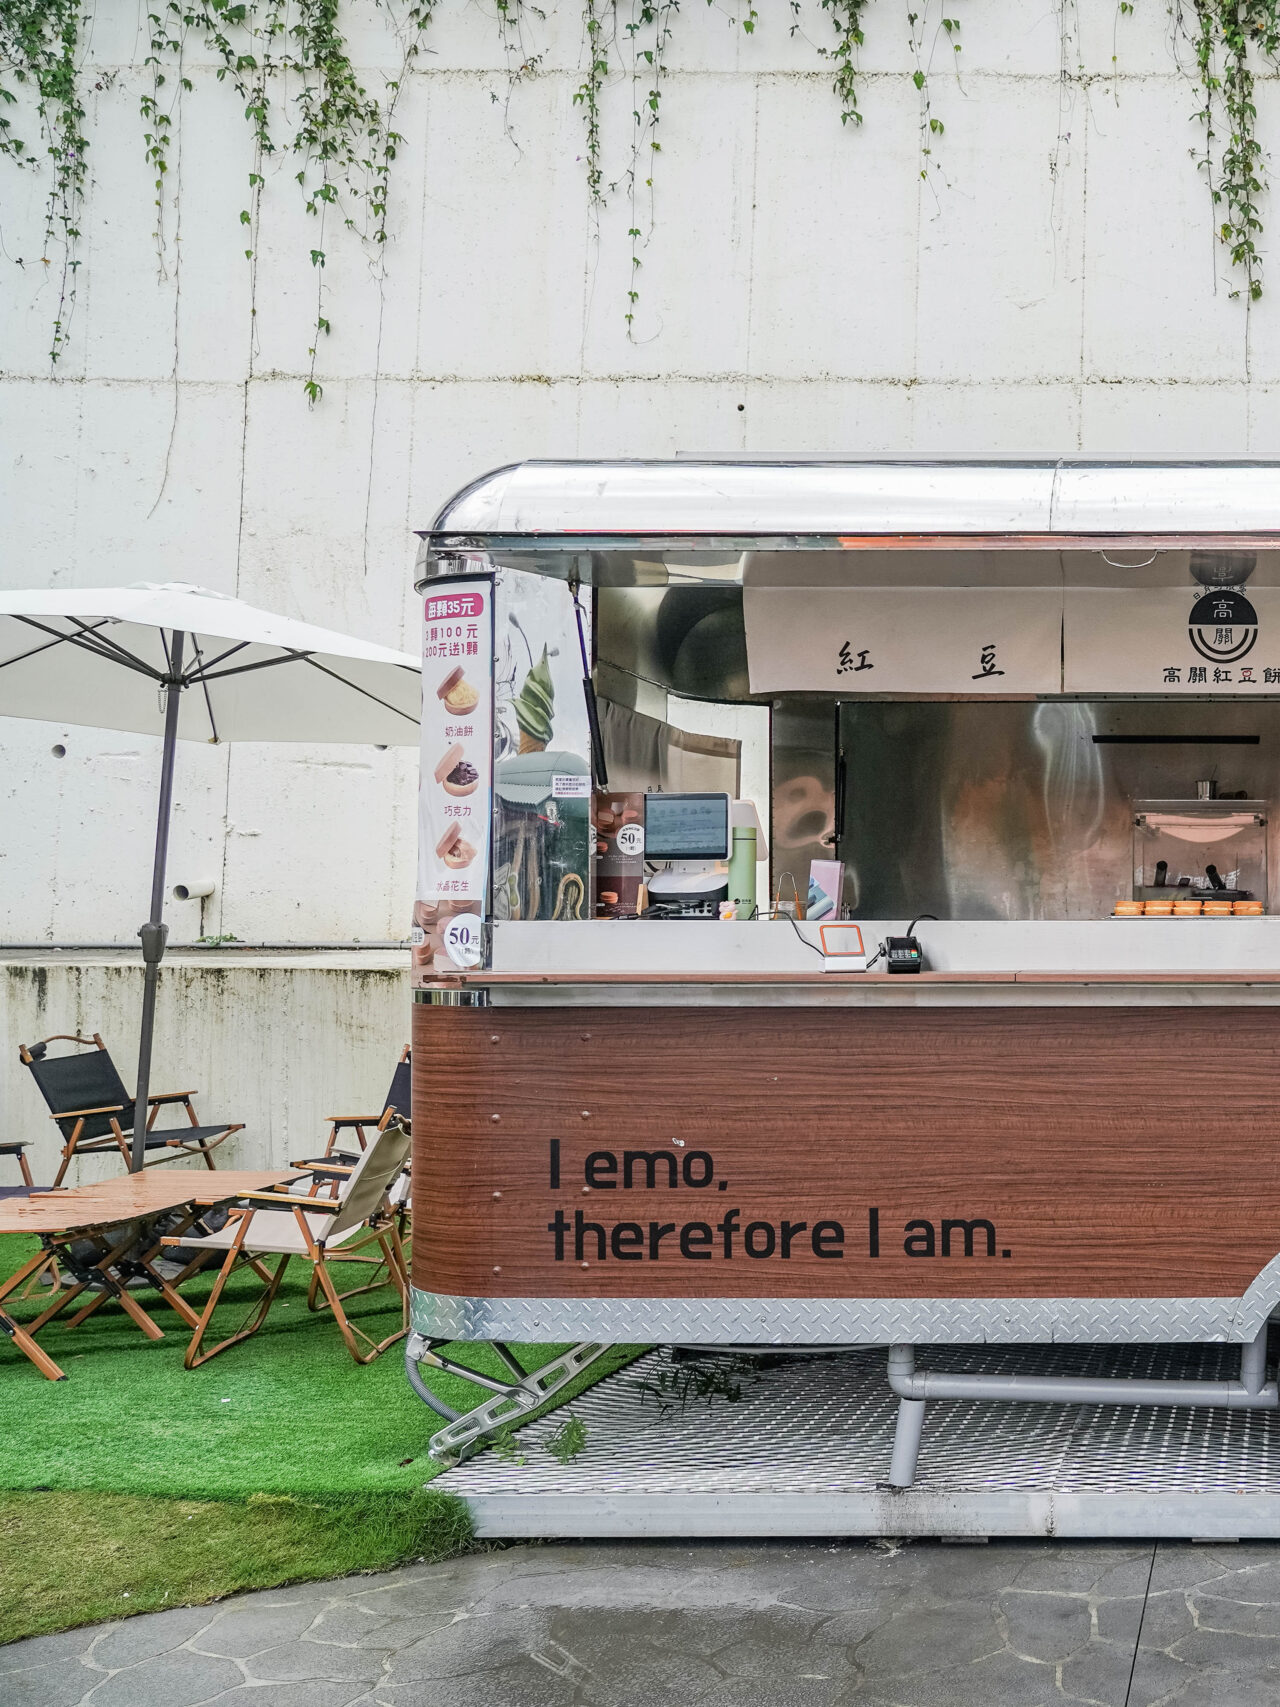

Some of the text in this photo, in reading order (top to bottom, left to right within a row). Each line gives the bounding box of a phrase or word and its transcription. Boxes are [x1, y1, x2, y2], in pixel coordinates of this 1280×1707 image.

[428, 598, 475, 619] 每顆35元
[1212, 599, 1234, 618] 高
[836, 640, 1005, 680] 紅 豆
[445, 726, 474, 738] 奶油餅
[444, 806, 472, 817] 巧克力
[436, 881, 469, 892] 水晶花生
[449, 927, 480, 945] 50元
[550, 1139, 728, 1192] I emo,
[548, 1208, 1012, 1261] therefore I am.
